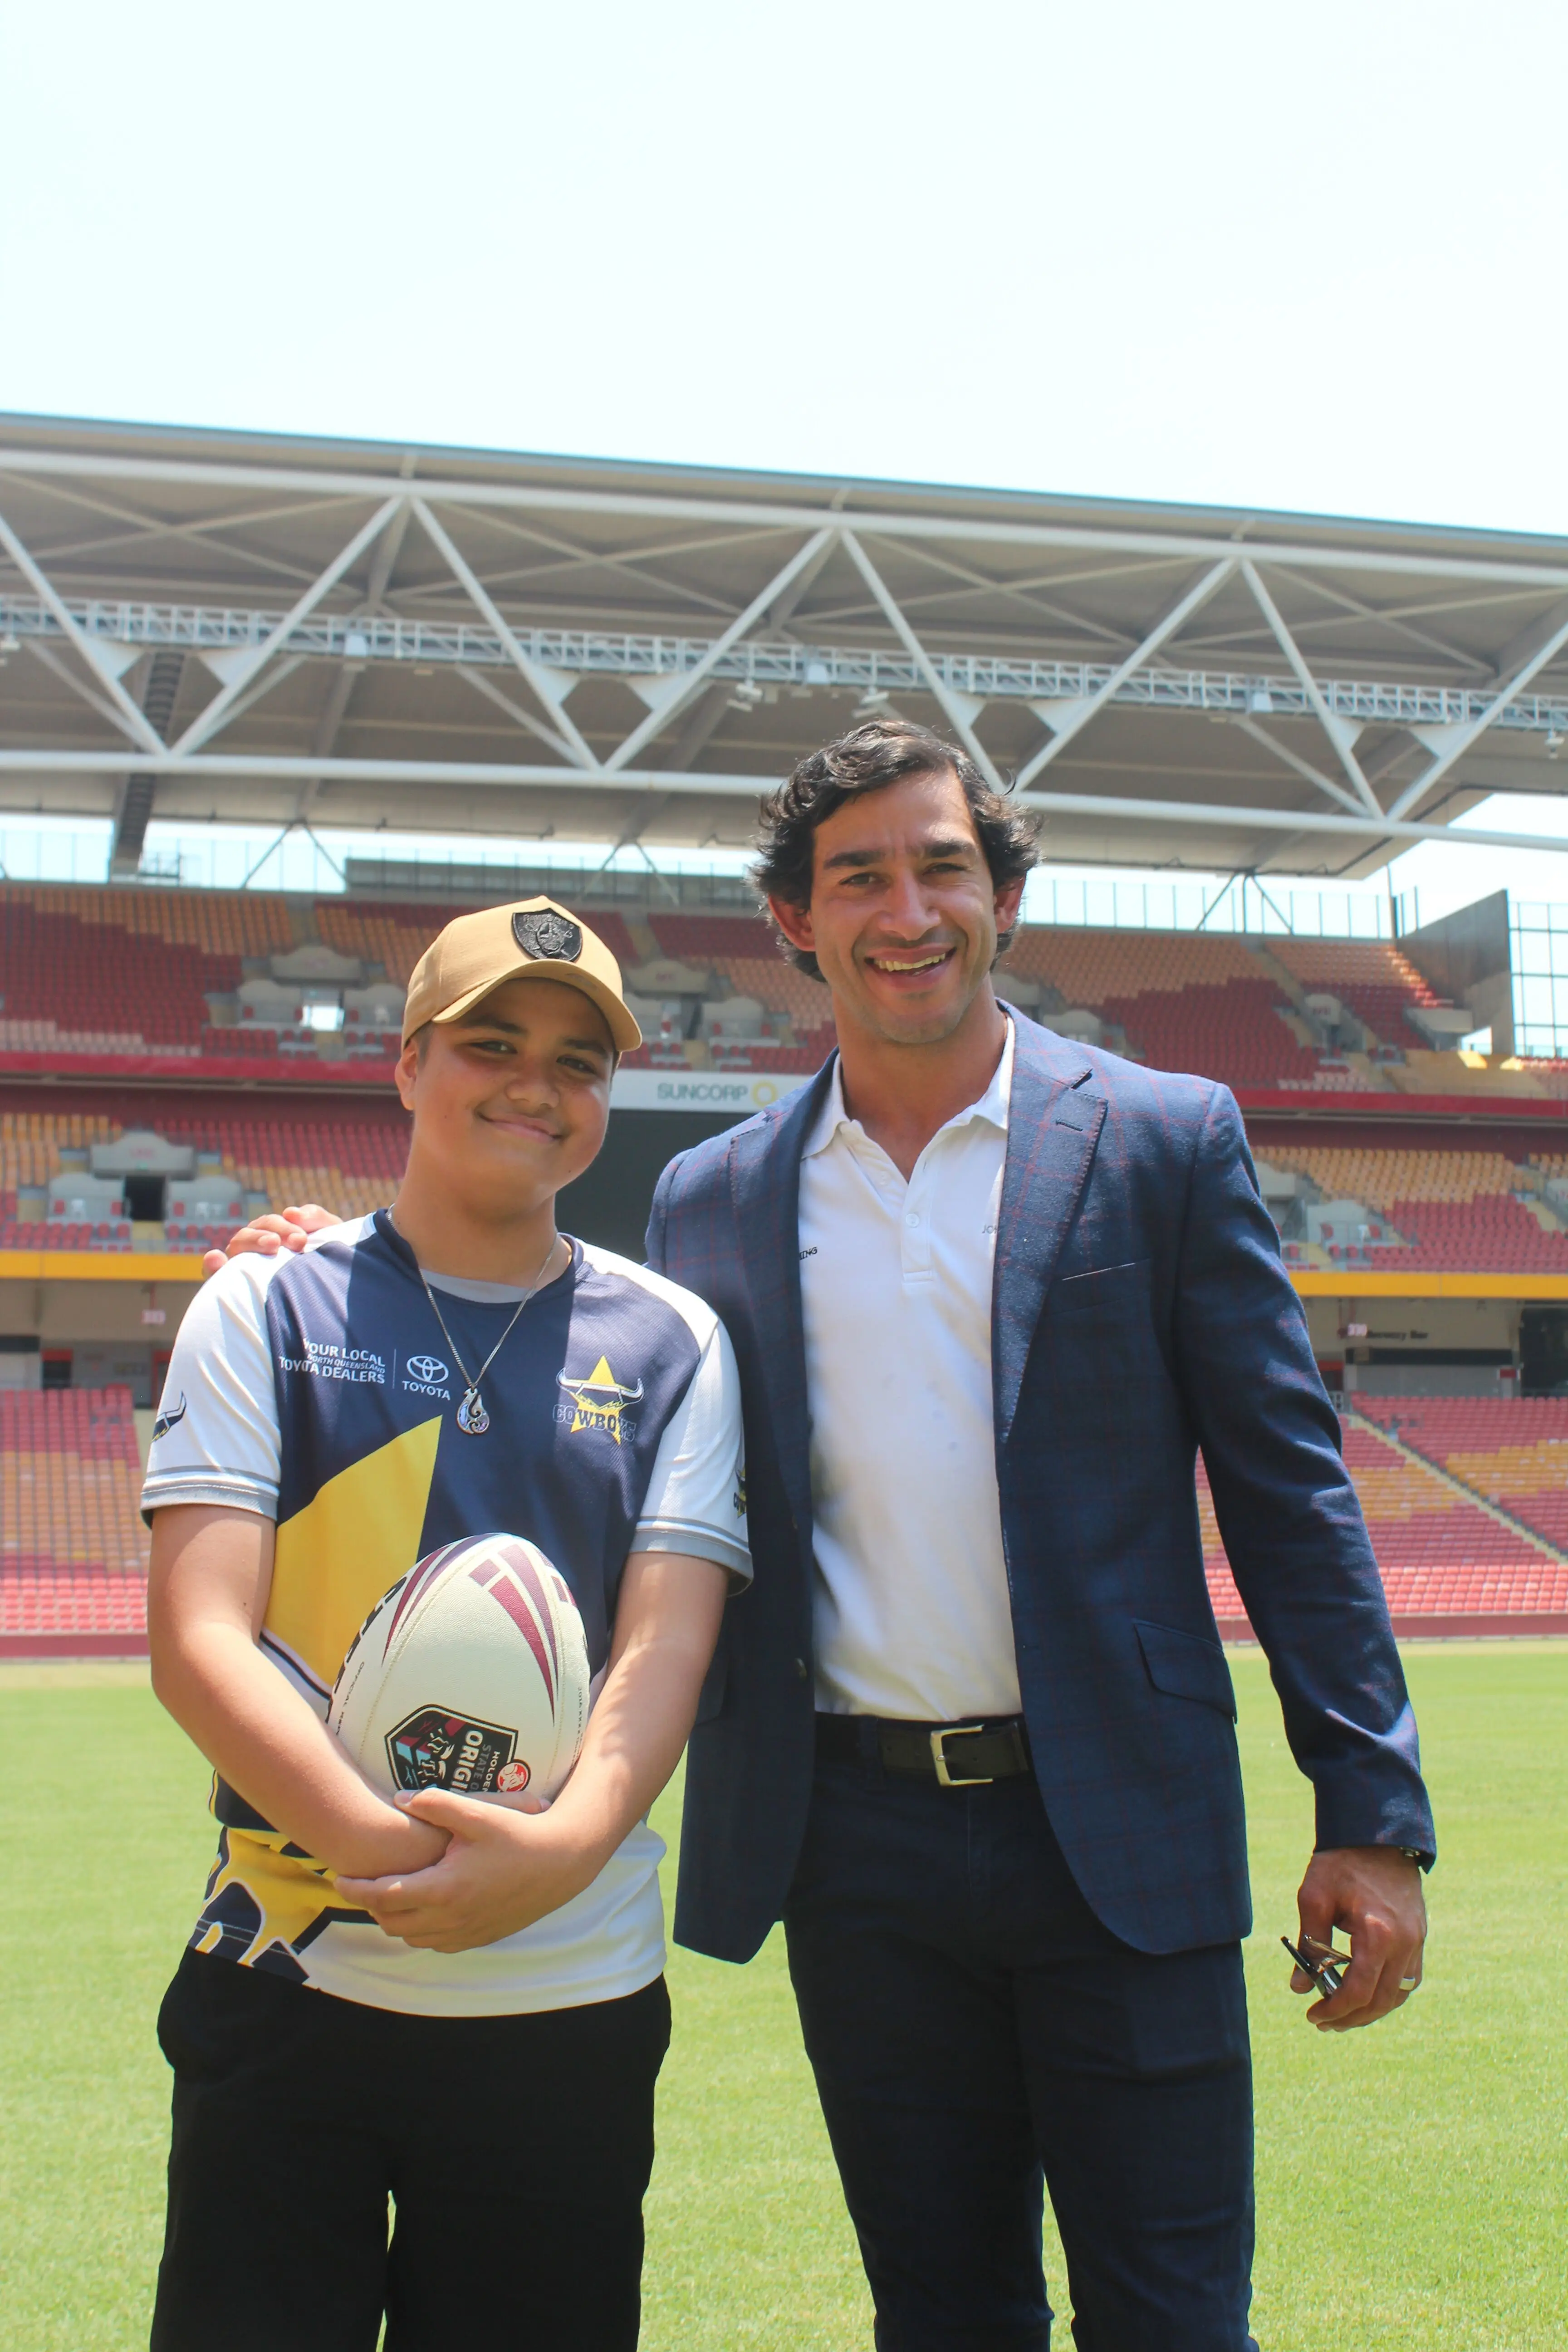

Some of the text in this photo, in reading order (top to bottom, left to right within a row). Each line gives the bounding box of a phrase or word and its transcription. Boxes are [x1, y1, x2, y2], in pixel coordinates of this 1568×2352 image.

[657, 1082, 749, 1101] SUNCORP
[303, 1338, 386, 1367] YOUR LOCAL
[307, 1353, 386, 1374] NORTH QUEENSLAND
[279, 1356, 385, 1384] TOYOTA DEALERS
[402, 1380, 451, 1401] TOYOTA
[473, 1744, 491, 1779] STATE
